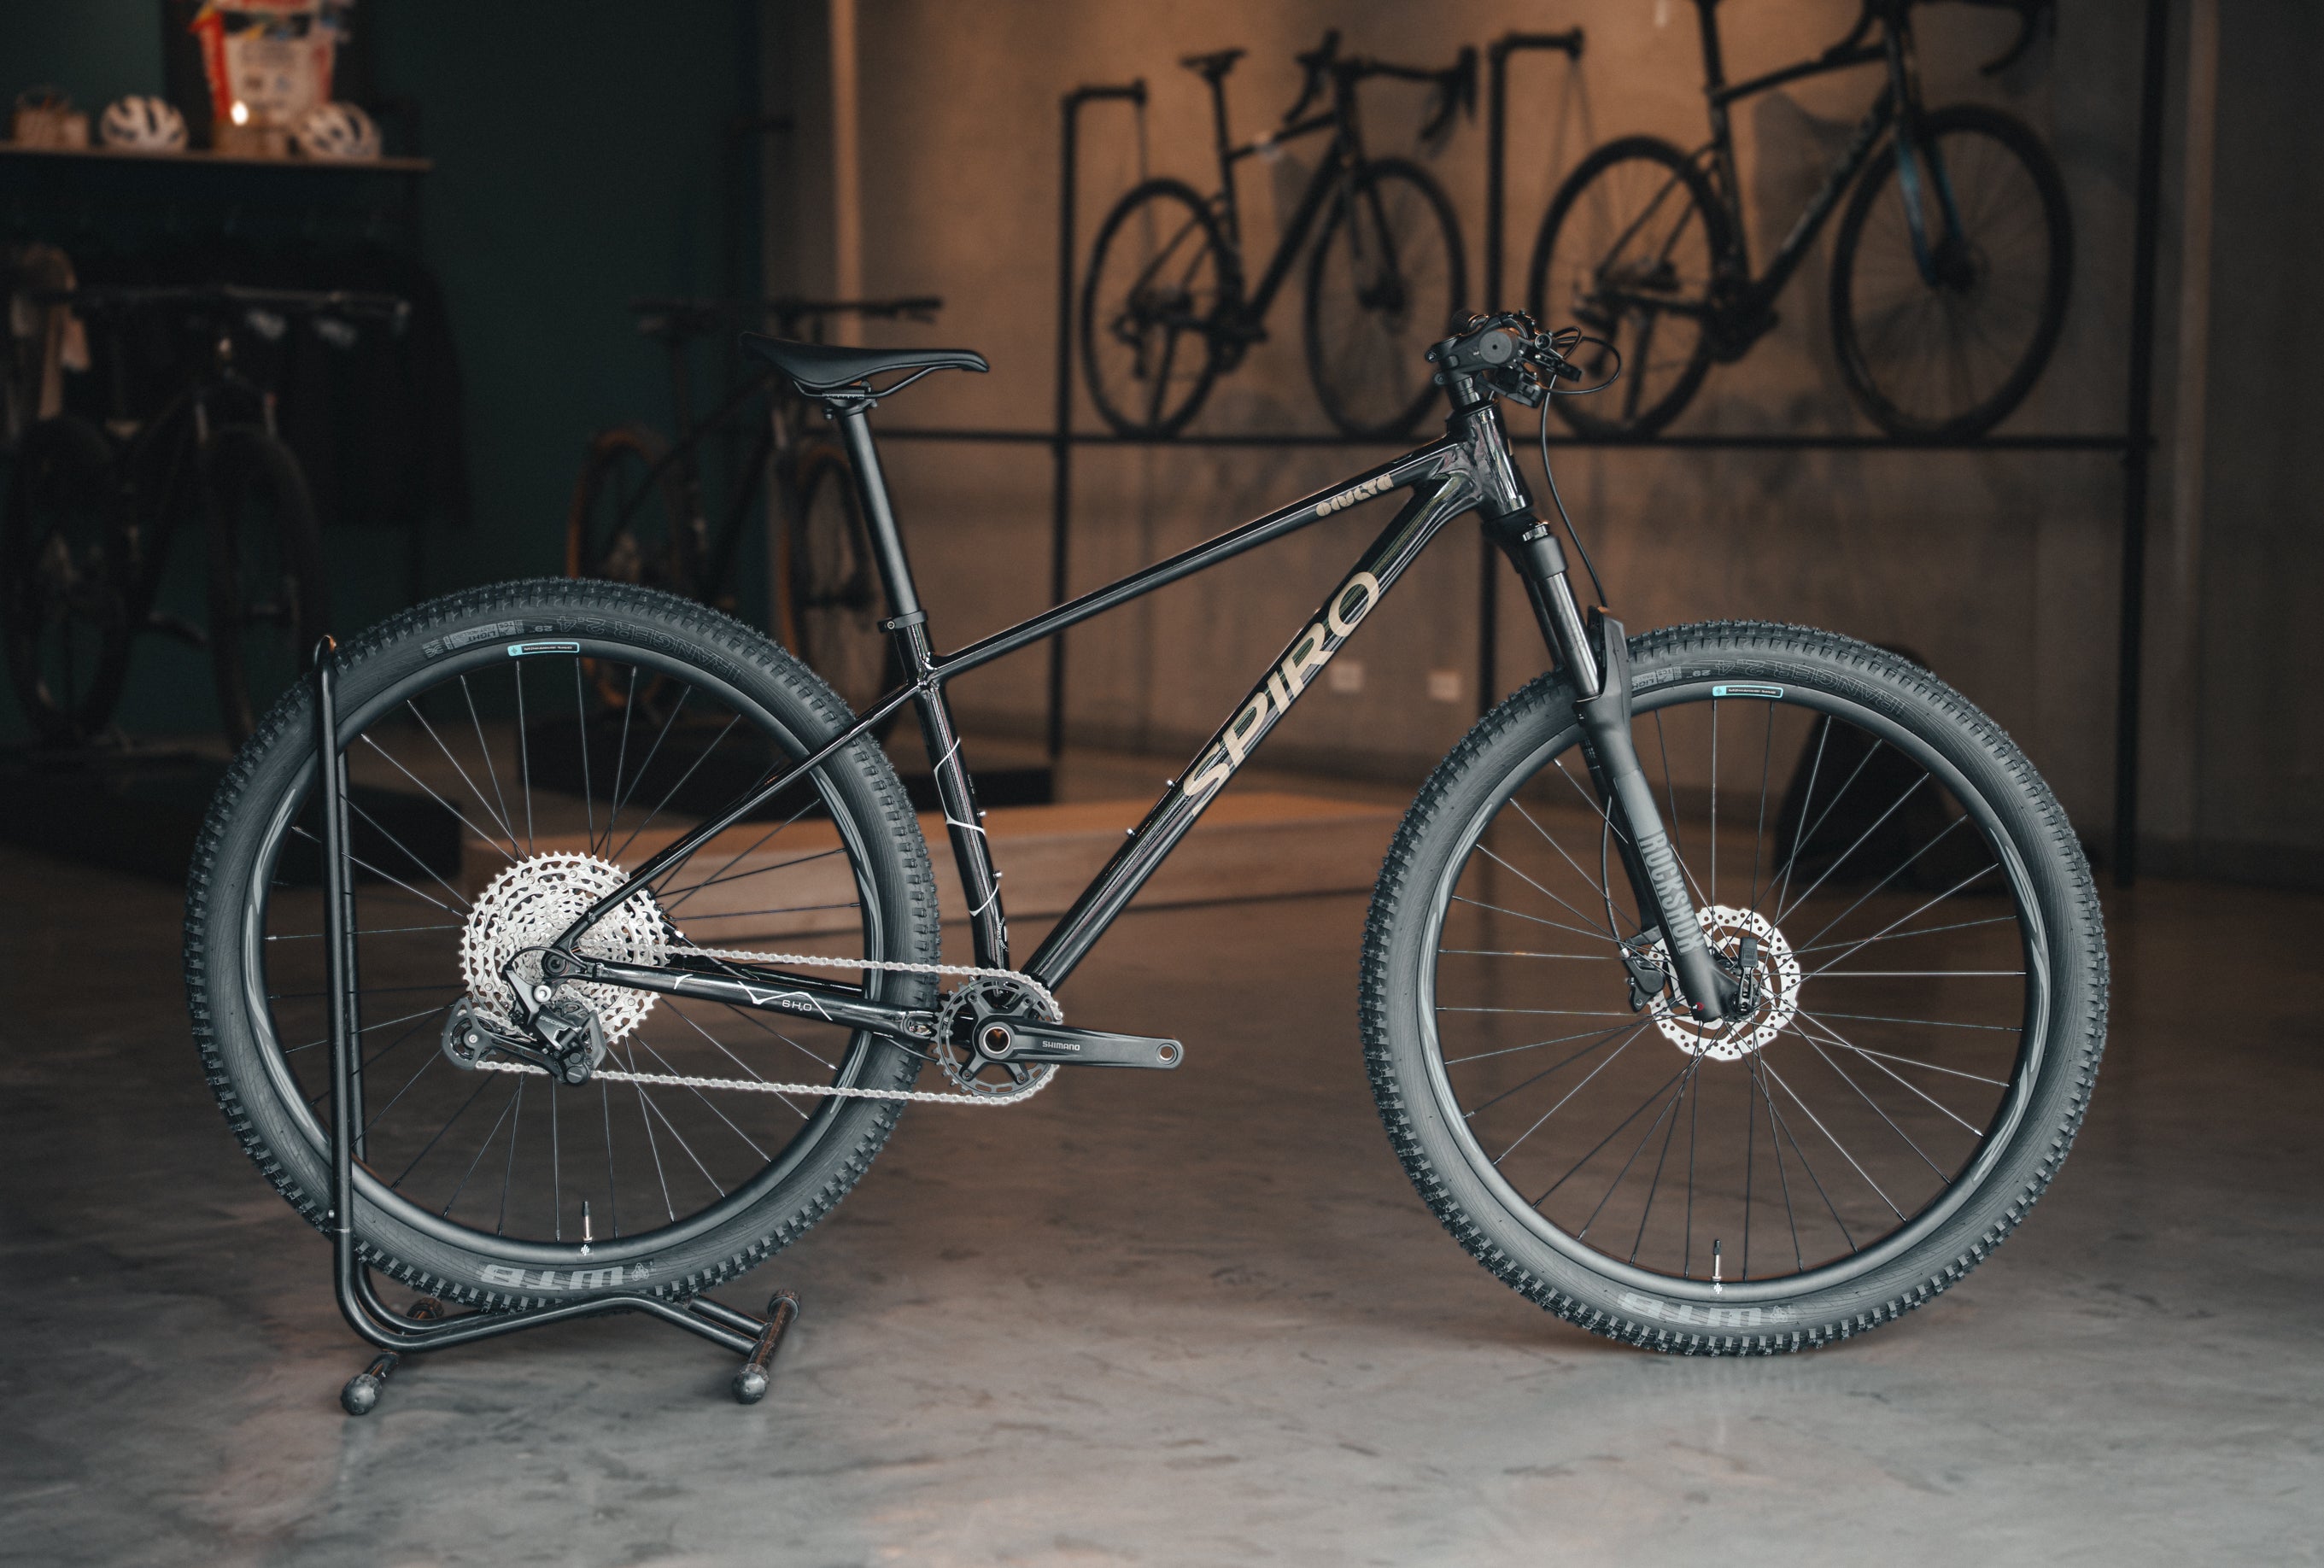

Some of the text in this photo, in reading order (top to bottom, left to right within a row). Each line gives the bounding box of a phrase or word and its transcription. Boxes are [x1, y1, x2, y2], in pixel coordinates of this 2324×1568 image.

[468, 630, 496, 641] LIGHT
[557, 617, 606, 634] 2.4
[1183, 571, 1379, 816] SPIRO
[1639, 831, 1706, 954] ROCKSHOX
[1042, 1040, 1080, 1051] SHIMANO
[480, 1264, 623, 1290] WTB
[1618, 1292, 1761, 1327] WTB
